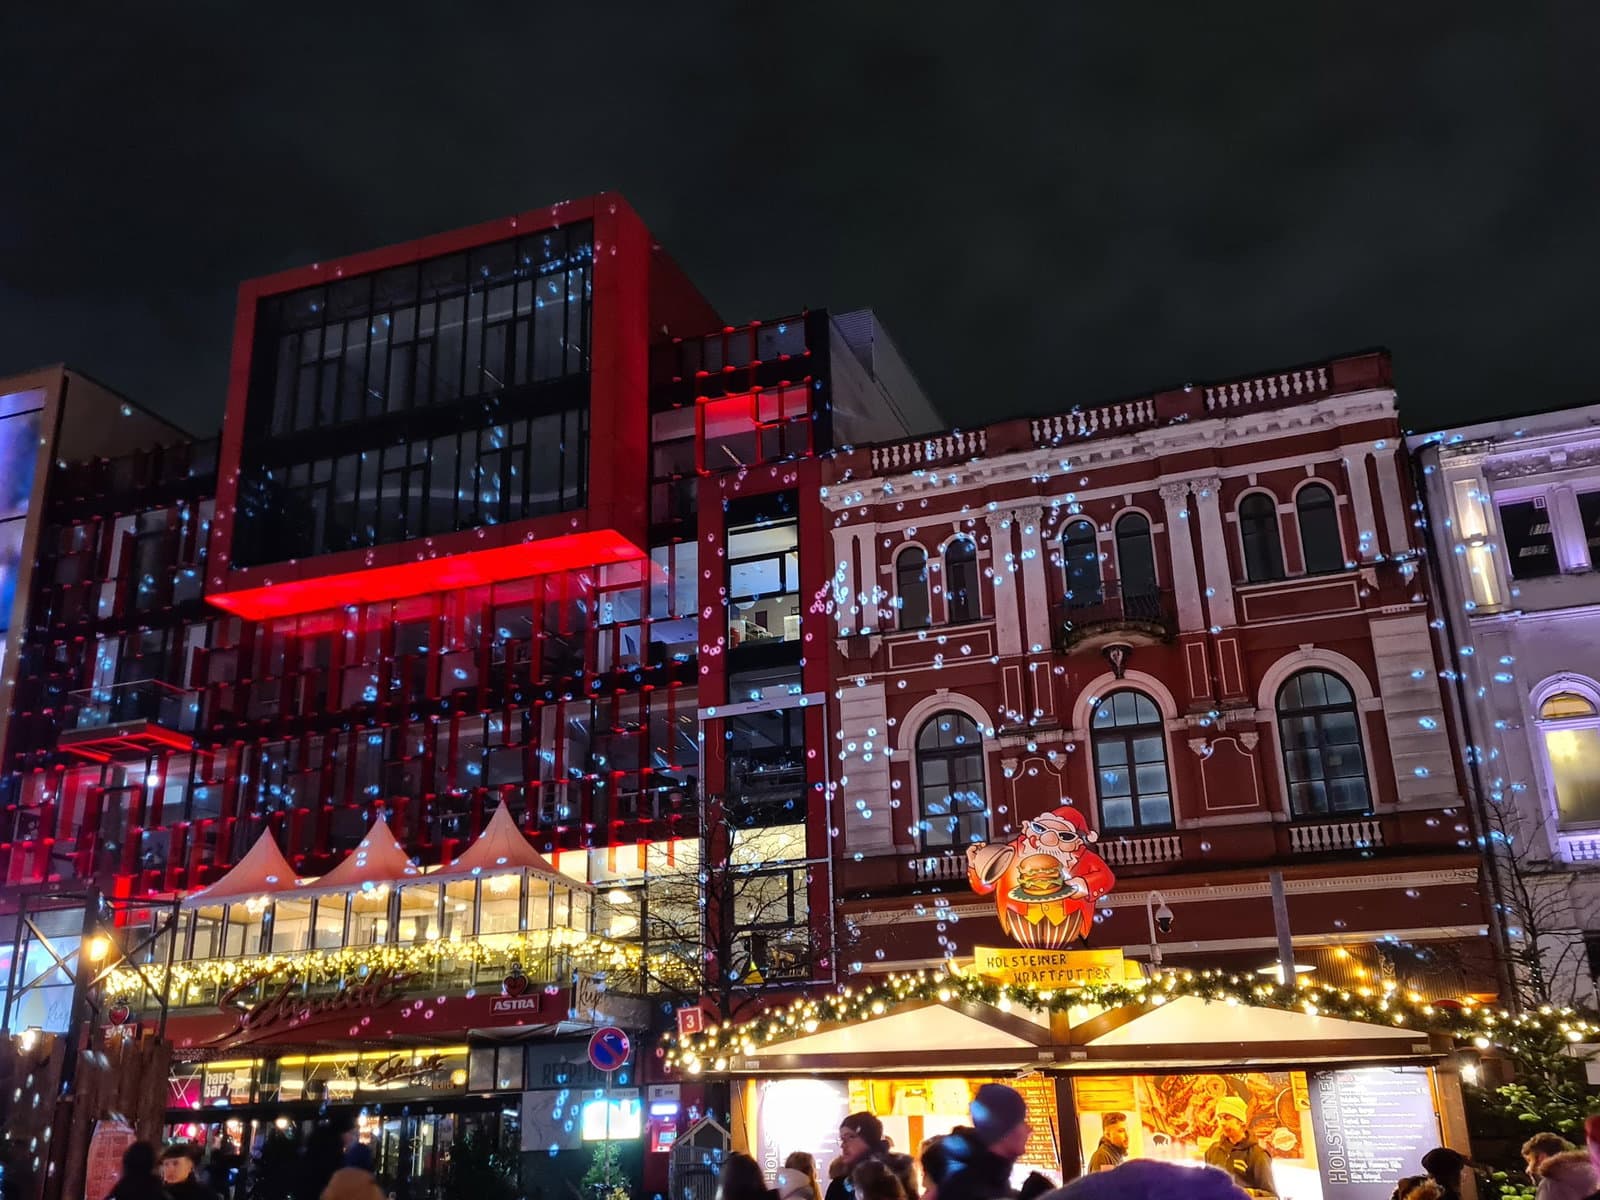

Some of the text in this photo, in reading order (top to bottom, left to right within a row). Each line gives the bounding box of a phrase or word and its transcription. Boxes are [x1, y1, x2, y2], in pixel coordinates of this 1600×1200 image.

[987, 954, 1067, 968] HOLSTEINER
[1014, 968, 1111, 983] KRAFTFUTTER
[494, 999, 535, 1010] ASTRA
[685, 1014, 695, 1029] 3
[205, 1070, 233, 1085] haus
[204, 1084, 225, 1098] bar
